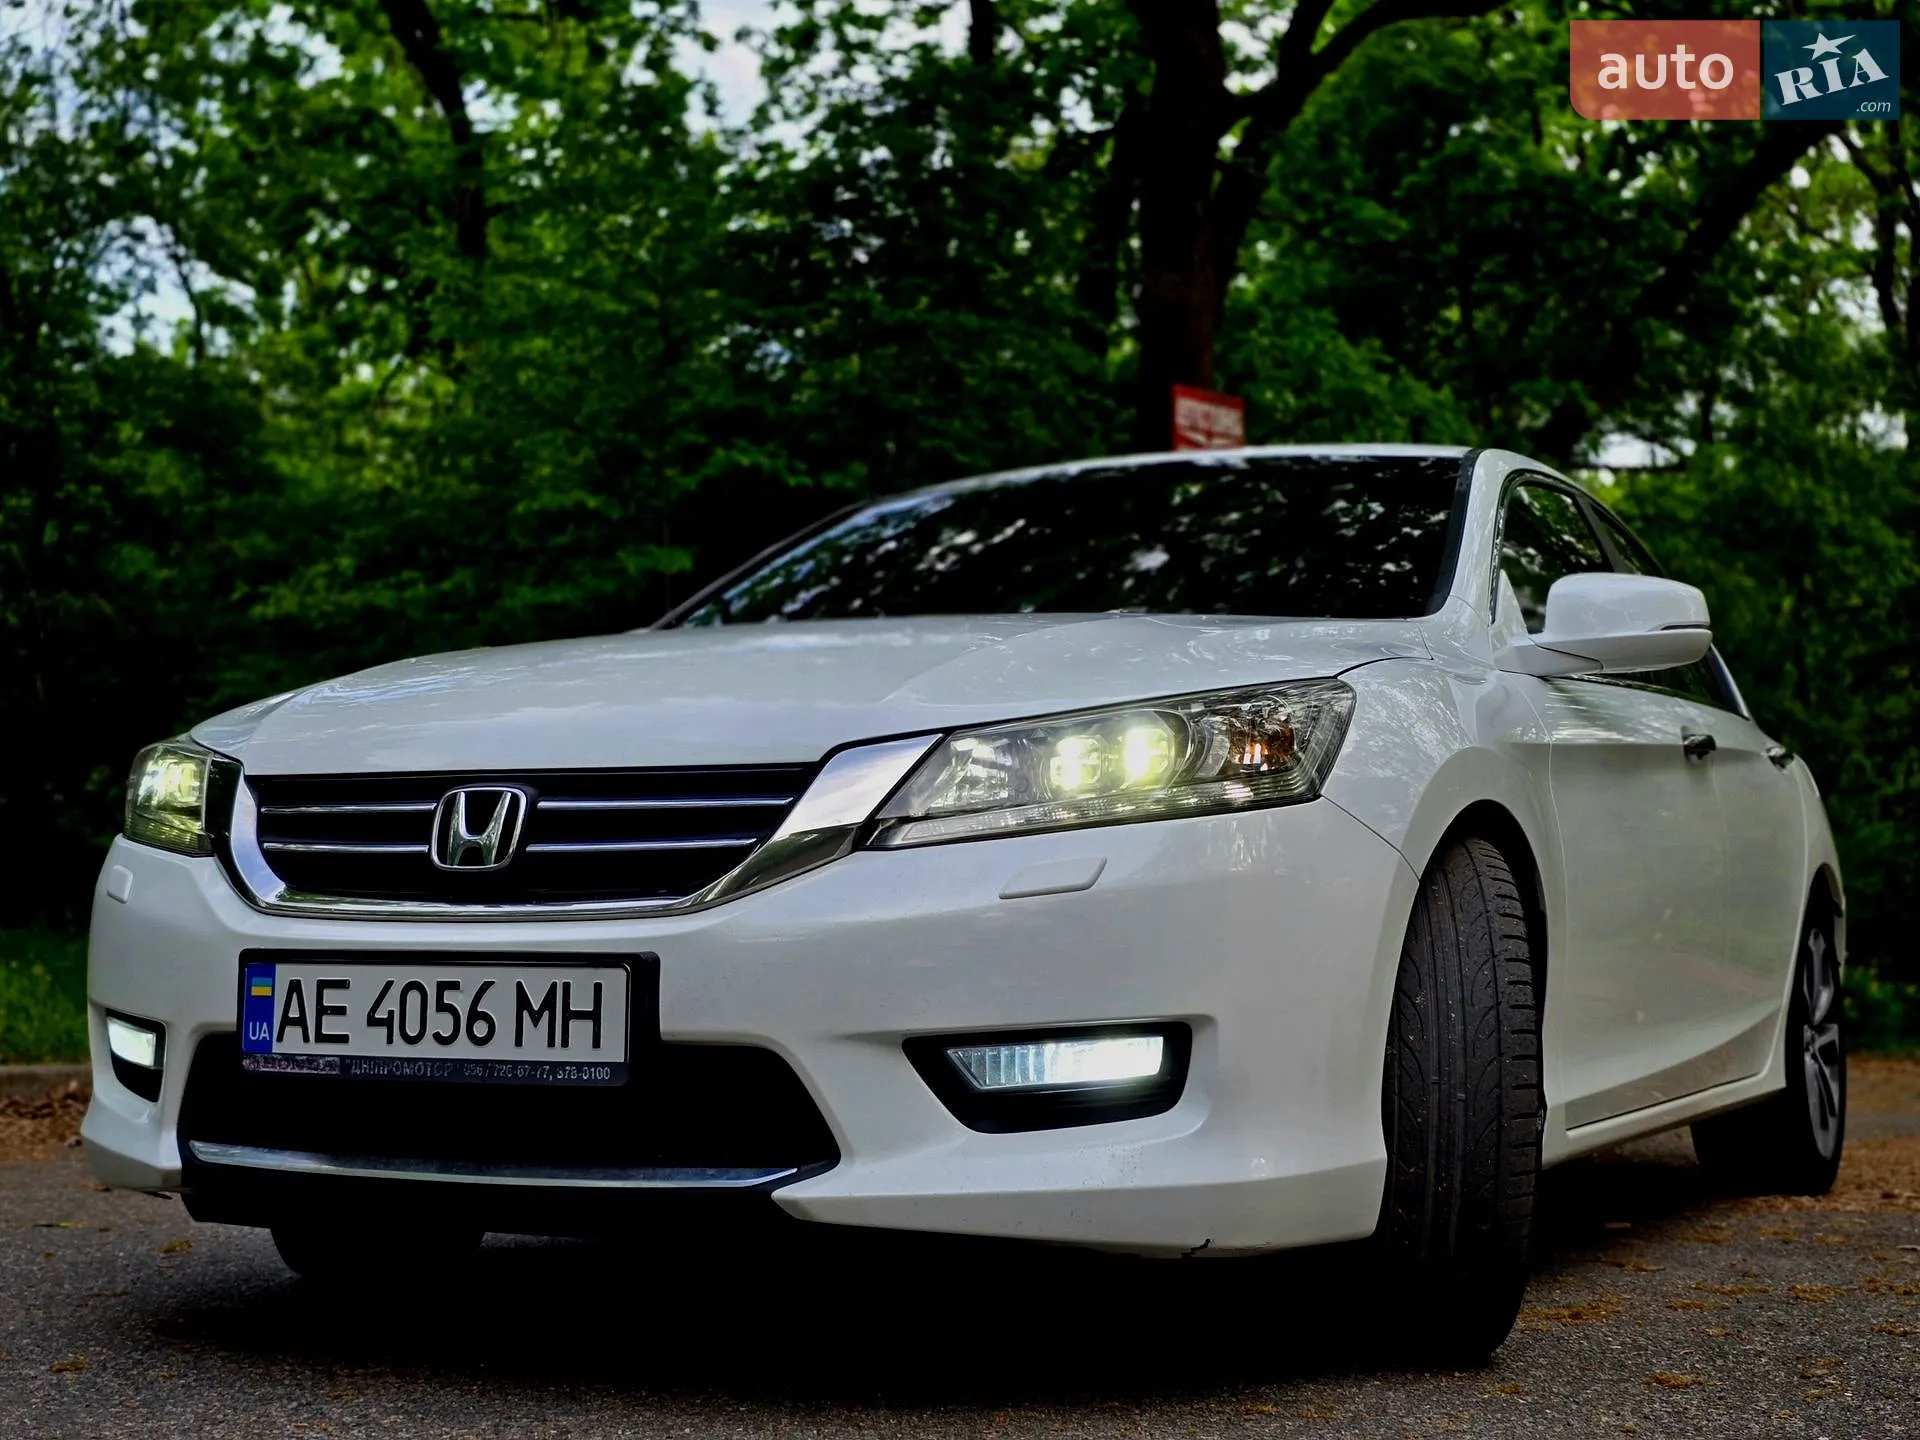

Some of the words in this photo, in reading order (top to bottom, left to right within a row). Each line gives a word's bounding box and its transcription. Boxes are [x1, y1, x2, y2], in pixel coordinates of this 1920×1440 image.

[249, 1022, 270, 1041] UA
[276, 977, 351, 1044] AE
[366, 979, 497, 1047] 4056
[514, 979, 603, 1049] MH
